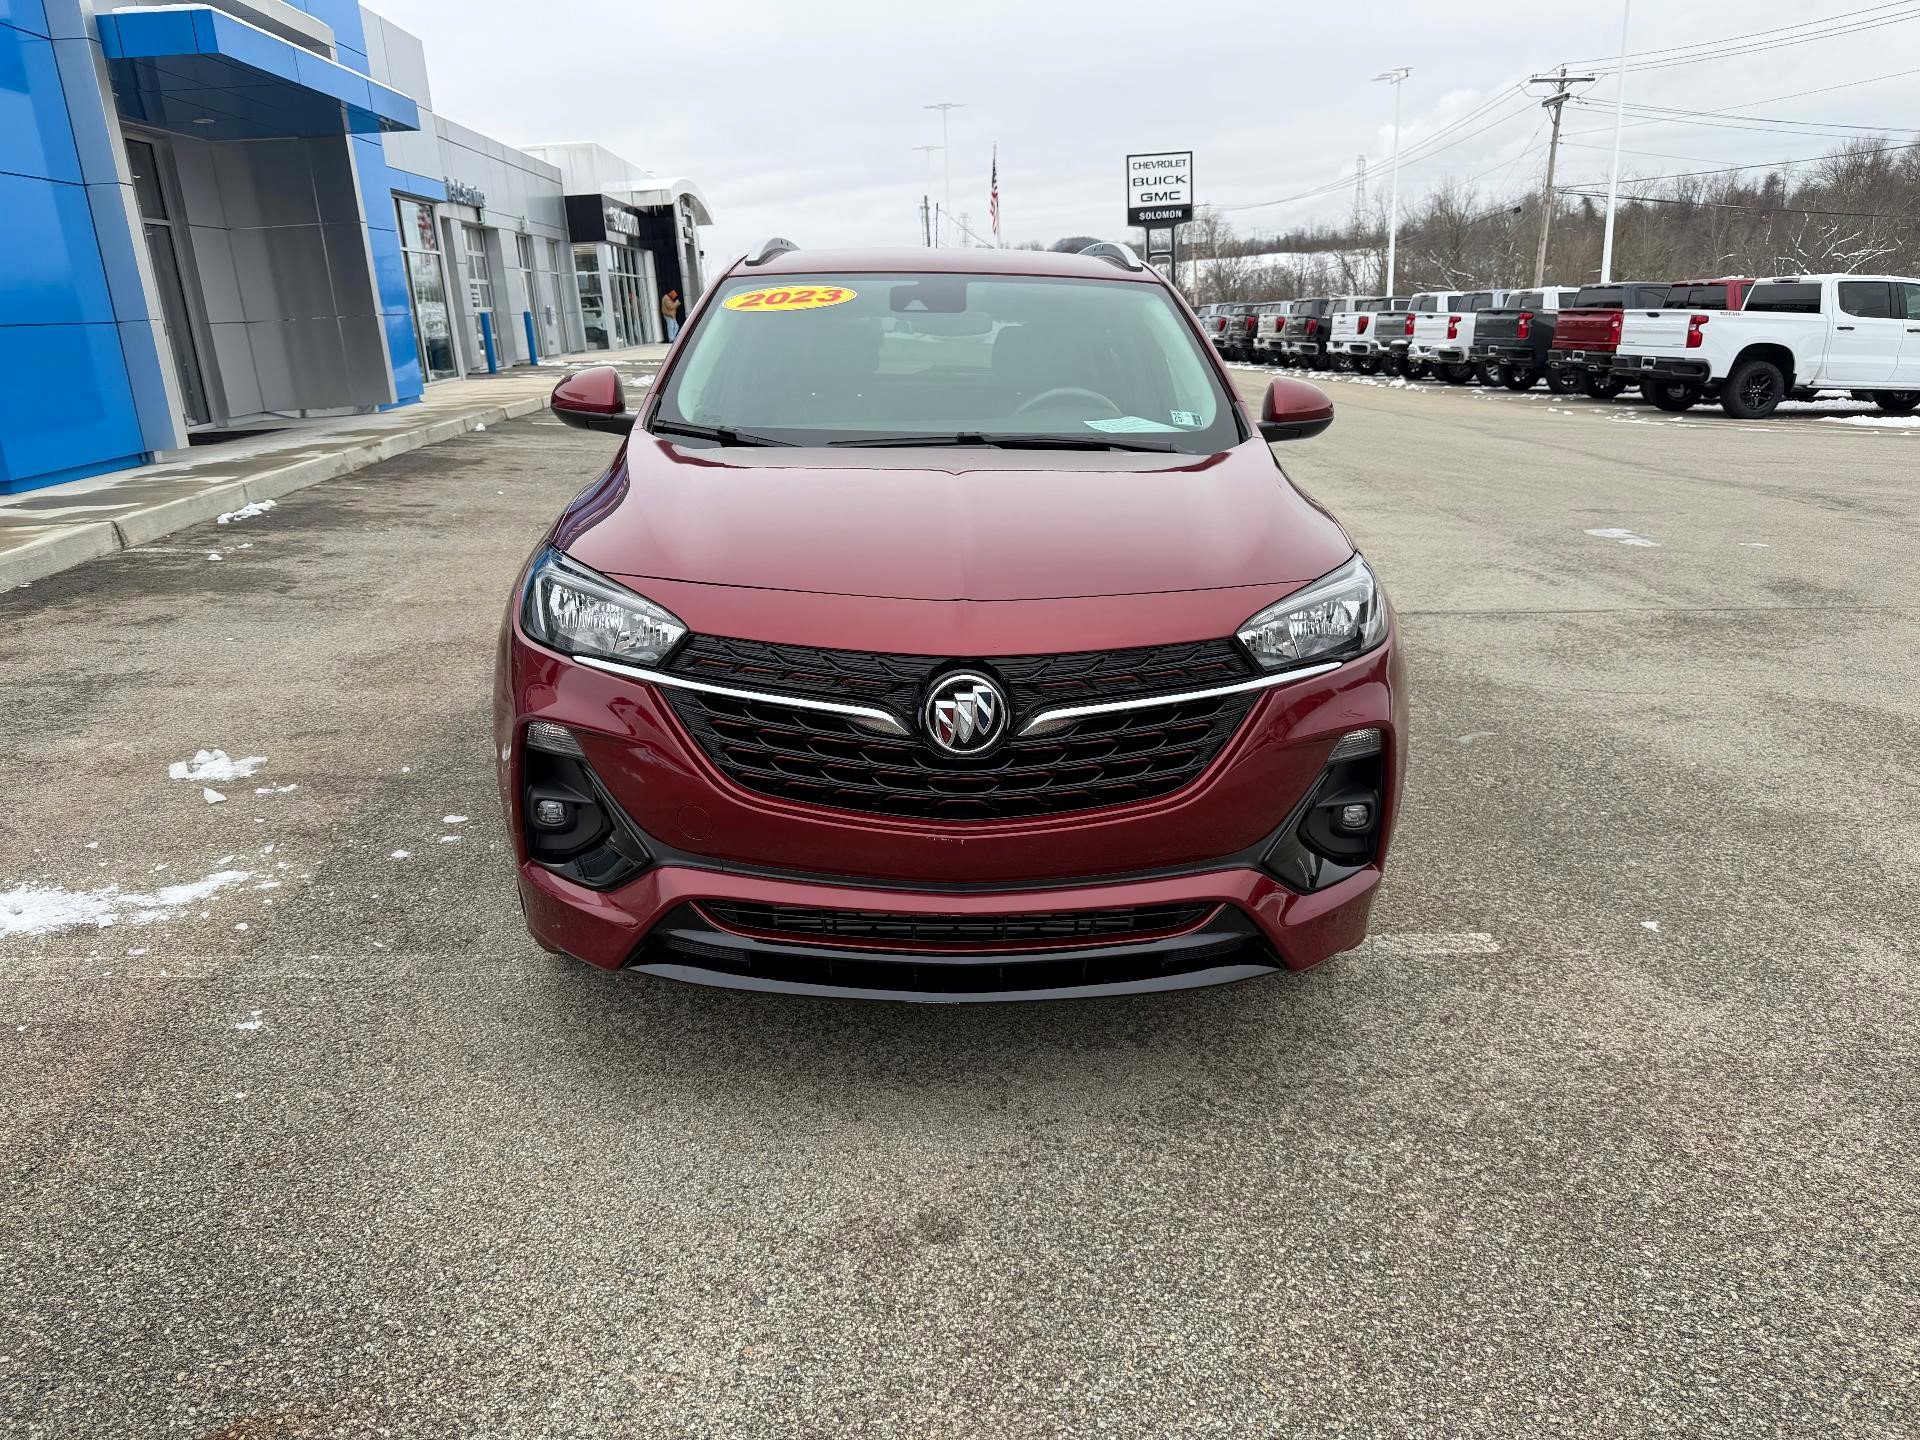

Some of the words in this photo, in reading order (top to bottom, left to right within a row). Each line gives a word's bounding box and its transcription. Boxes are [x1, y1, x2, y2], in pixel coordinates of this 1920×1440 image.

[1132, 159, 1187, 170] CHEVROLET
[1132, 175, 1187, 187] BUICK
[1140, 191, 1181, 202] GMC
[1139, 210, 1183, 220] SOLOMON
[737, 289, 844, 308] 2023
